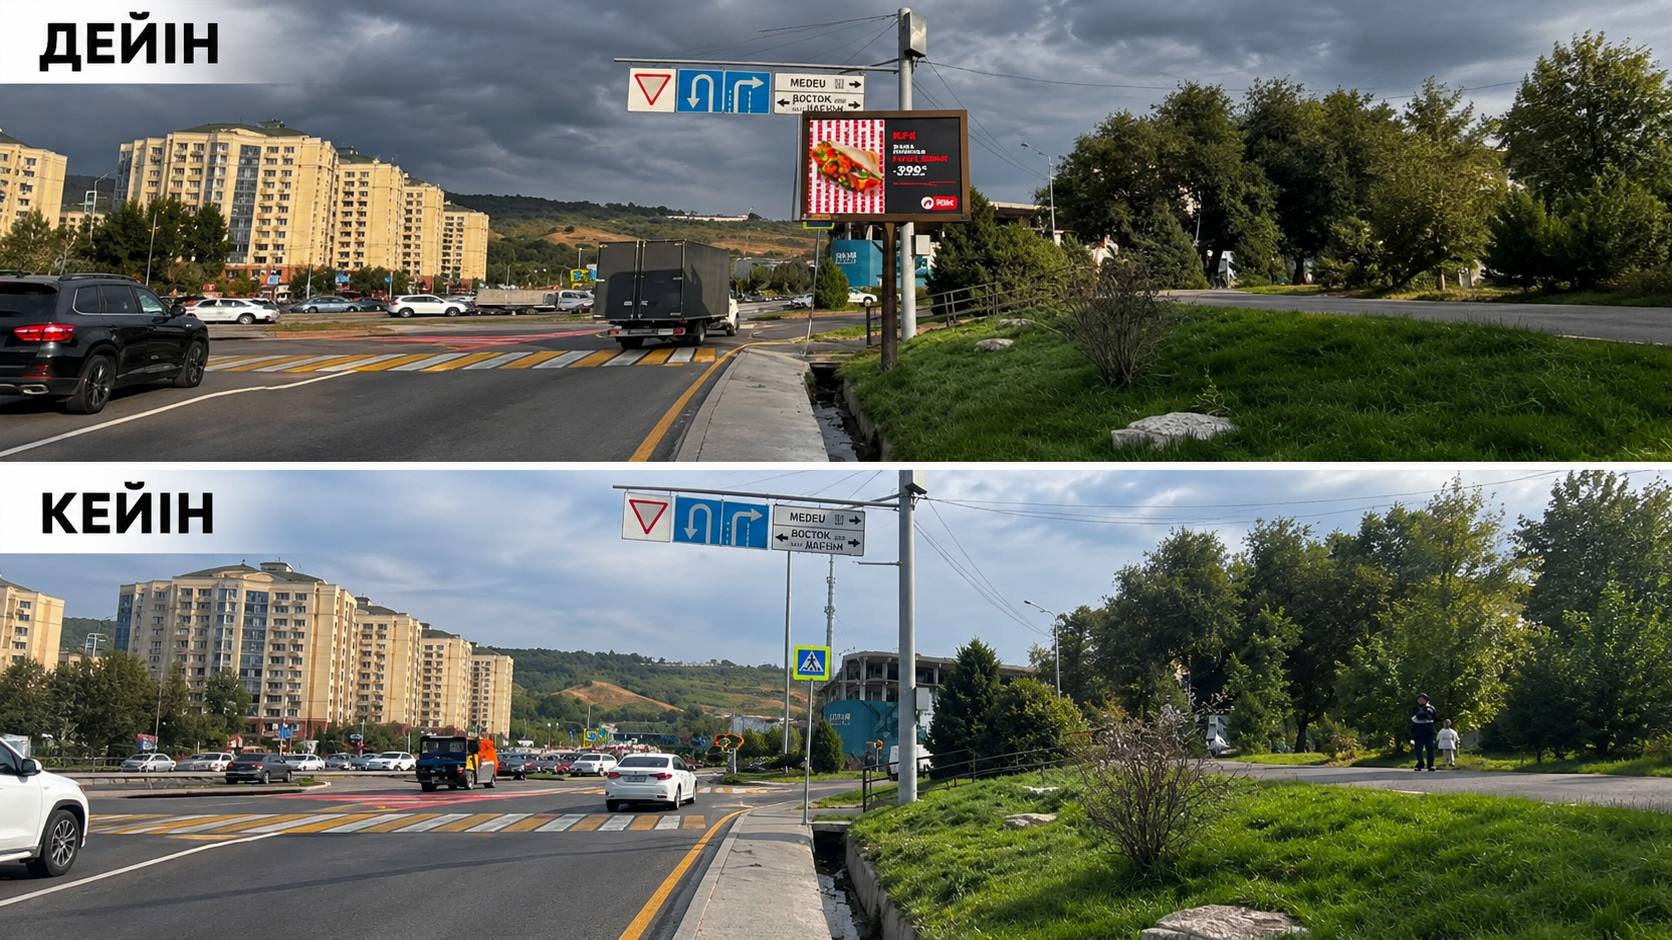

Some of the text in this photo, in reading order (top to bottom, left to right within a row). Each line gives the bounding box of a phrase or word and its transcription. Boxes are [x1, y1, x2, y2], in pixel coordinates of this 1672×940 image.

[790, 78, 826, 88] MEDEU
[789, 512, 826, 523] MEDEU
[791, 528, 831, 540] ВОСТОК
